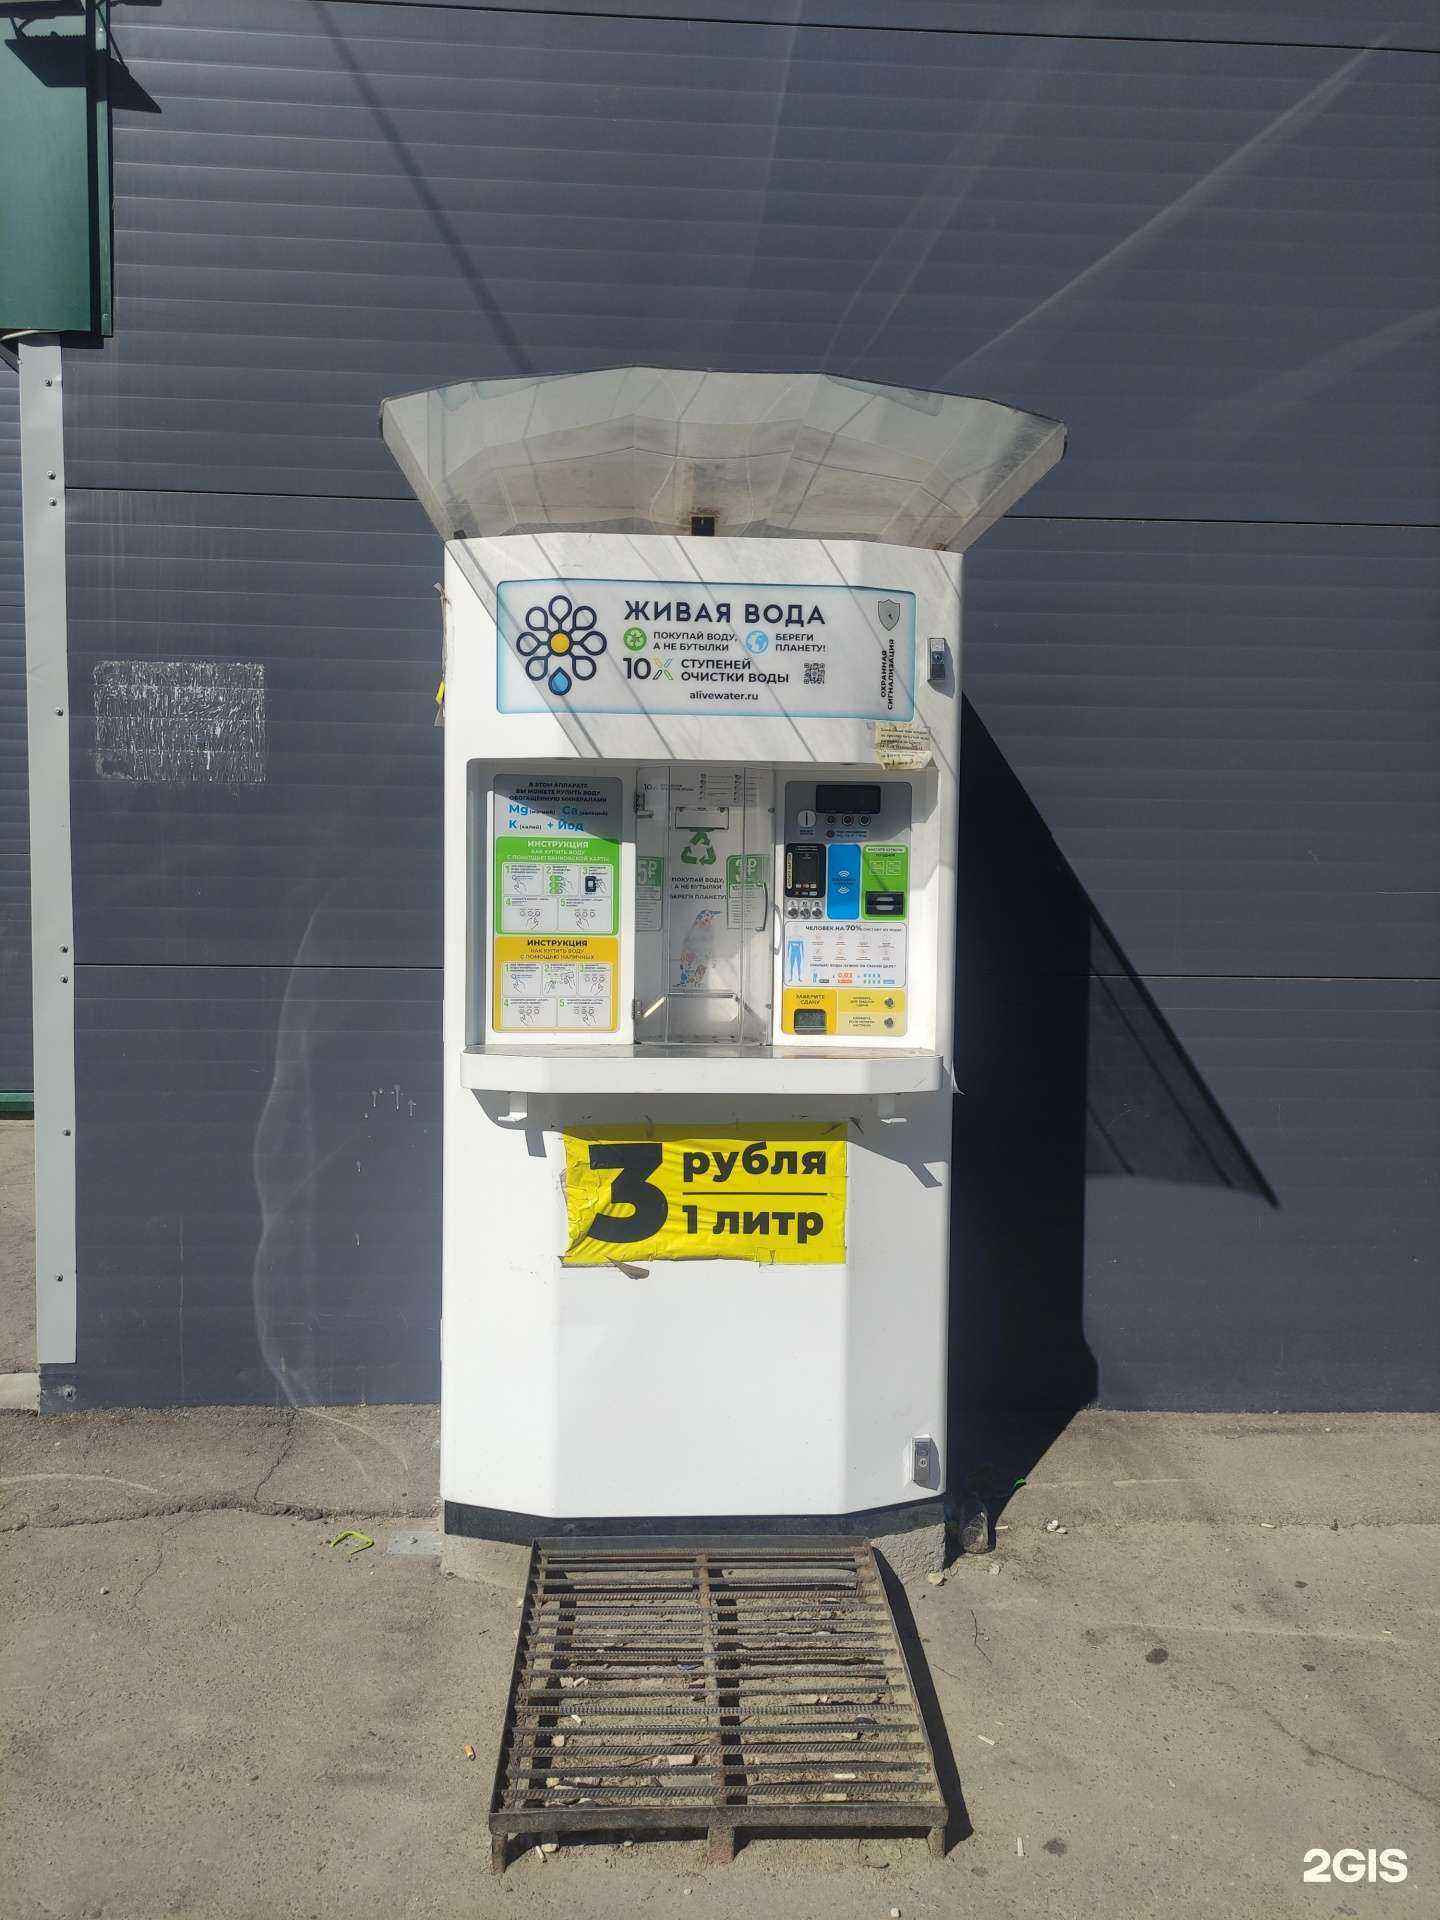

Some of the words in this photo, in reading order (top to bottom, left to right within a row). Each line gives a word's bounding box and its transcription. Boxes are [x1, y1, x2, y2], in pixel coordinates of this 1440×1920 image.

[624, 600, 732, 624] ЖИВАЯ
[744, 603, 826, 627] ВОДА
[653, 630, 704, 641] ПОКУПАЙ
[706, 632, 738, 643] ВОДУ,
[775, 633, 814, 642] БЕРЕГИ
[653, 642, 661, 650] А
[663, 642, 677, 651] НЕ
[679, 642, 729, 652] БУТЫЛКИ
[775, 643, 826, 652] ПЛАНЕТУ!
[681, 657, 751, 670] СТУПЕНЕЙ
[681, 671, 745, 682] ОЧИСТКИ
[748, 673, 789, 684] ВОДЫ
[887, 639, 895, 711] СИГНАЛИЗАЦИЯ
[689, 690, 759, 701] alivewater.ru
[508, 804, 529, 815] Mg
[508, 819, 518, 829] K
[557, 817, 584, 831] Йод
[527, 840, 589, 848] ИНСТРУКЦИЯ
[846, 924, 863, 932] 70%
[527, 939, 588, 947] ИНСТРУКЦИЯ
[683, 1141, 827, 1182] рубля
[588, 1142, 669, 1244] 3
[682, 1205, 698, 1235] 1
[713, 1211, 824, 1244] литр
